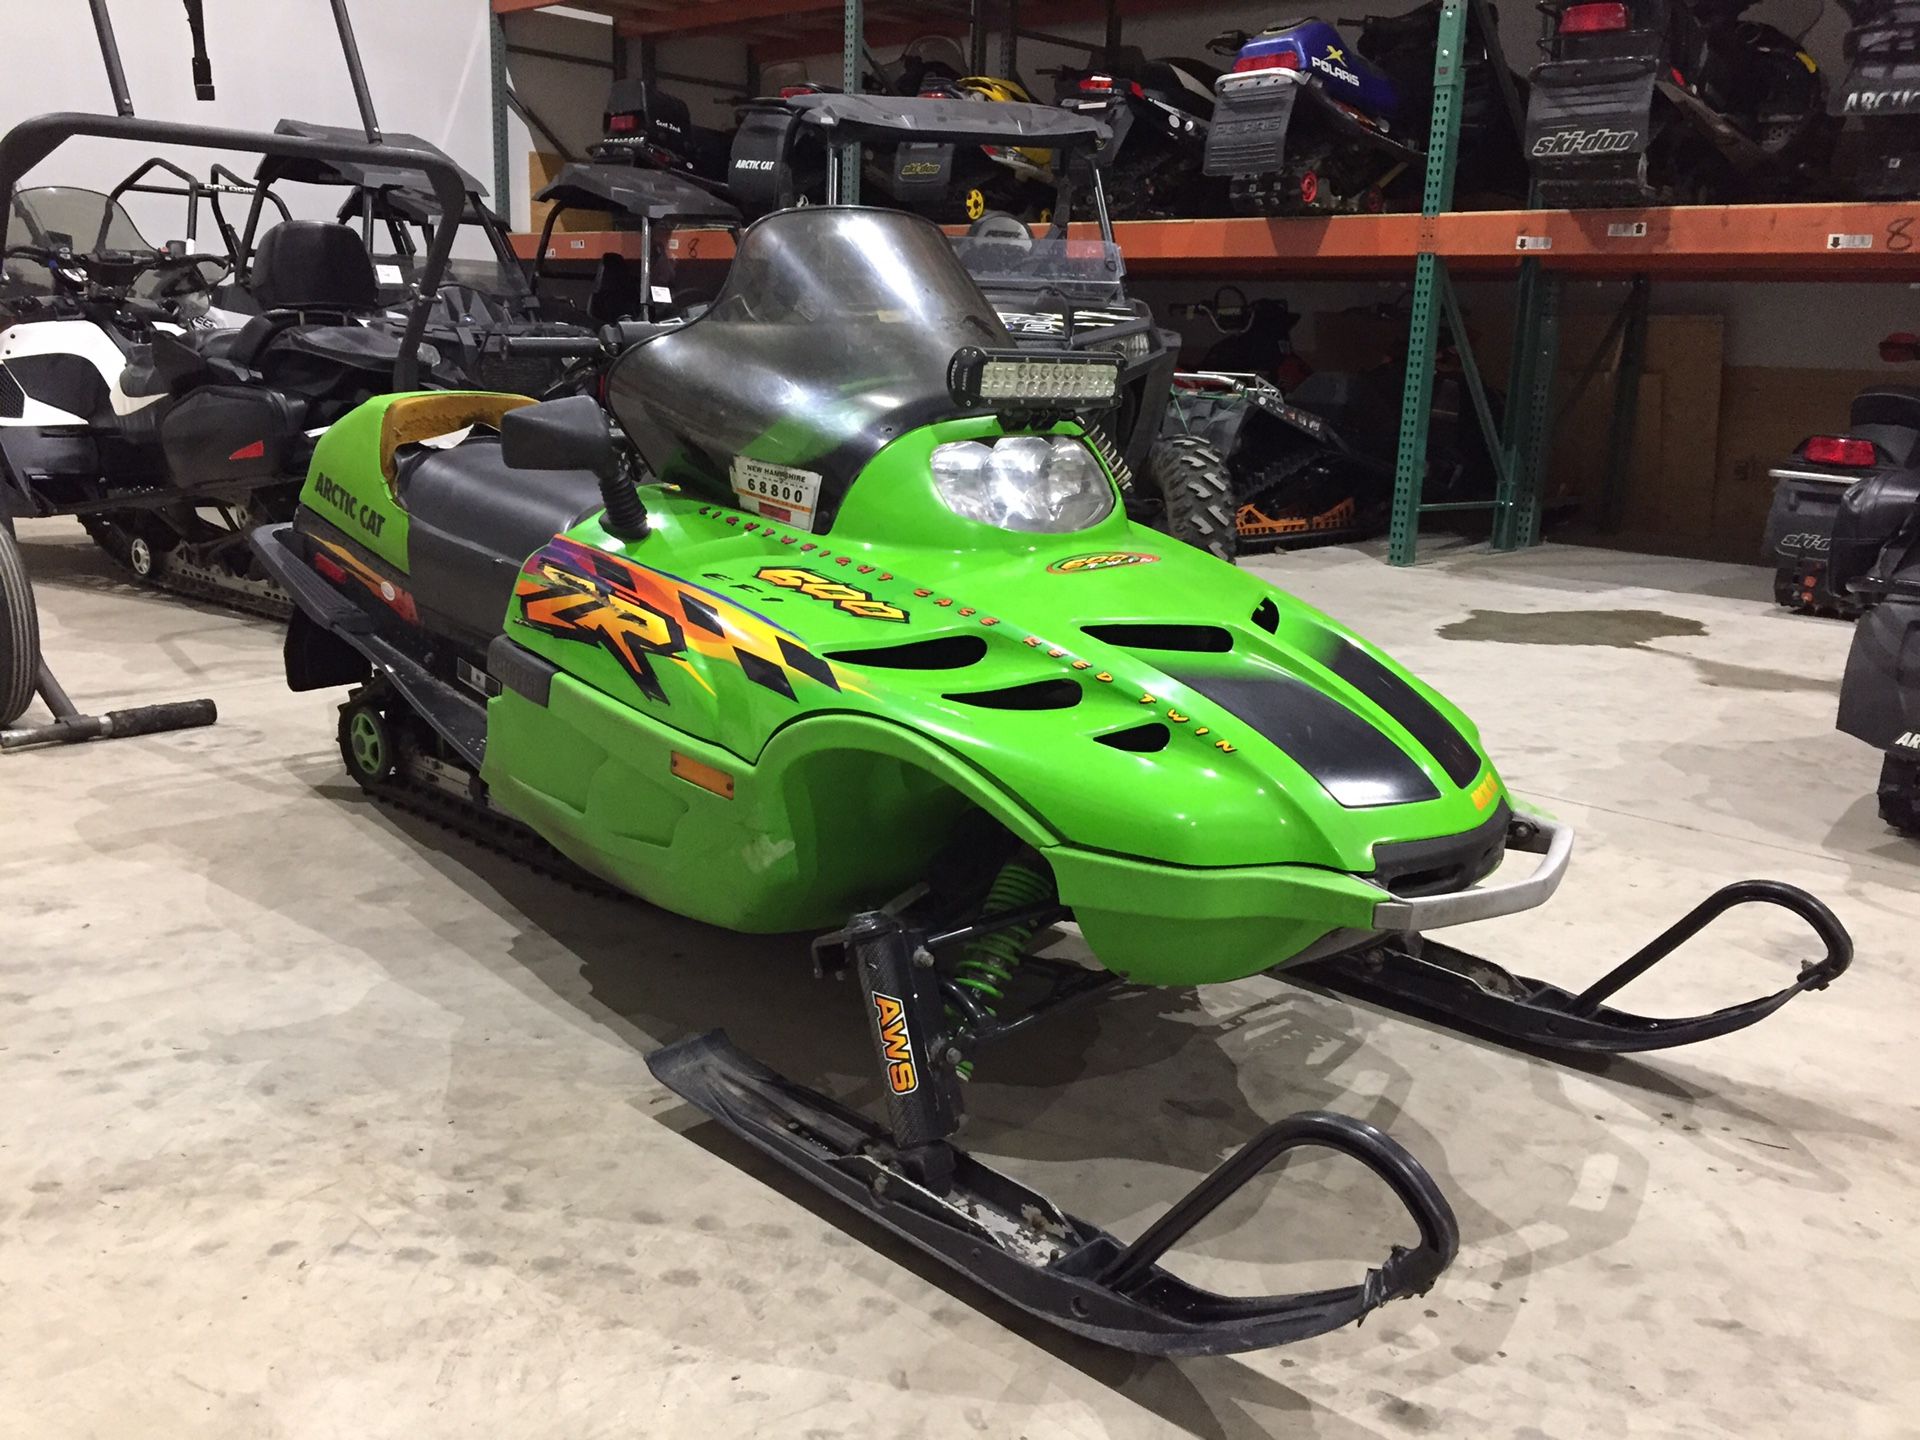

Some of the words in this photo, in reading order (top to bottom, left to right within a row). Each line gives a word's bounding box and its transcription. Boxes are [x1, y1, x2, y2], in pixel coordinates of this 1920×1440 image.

[1311, 56, 1360, 87] POLARIS
[1213, 117, 1283, 136] POLARIS
[1531, 129, 1639, 157] ski-doo
[735, 159, 761, 170] ARCTIC
[760, 161, 775, 171] CAT
[1886, 216, 1916, 251] 8
[687, 238, 700, 258] 8
[747, 464, 763, 474] NEW
[764, 467, 807, 483] HAMPSHIRE
[314, 471, 358, 520] ARCTIC
[359, 504, 387, 538] CAT
[747, 478, 803, 503] 68800
[514, 556, 688, 707] ZR
[1138, 693, 1237, 754] TWIN
[1894, 731, 1920, 749] AR
[872, 990, 919, 1096] AWS
